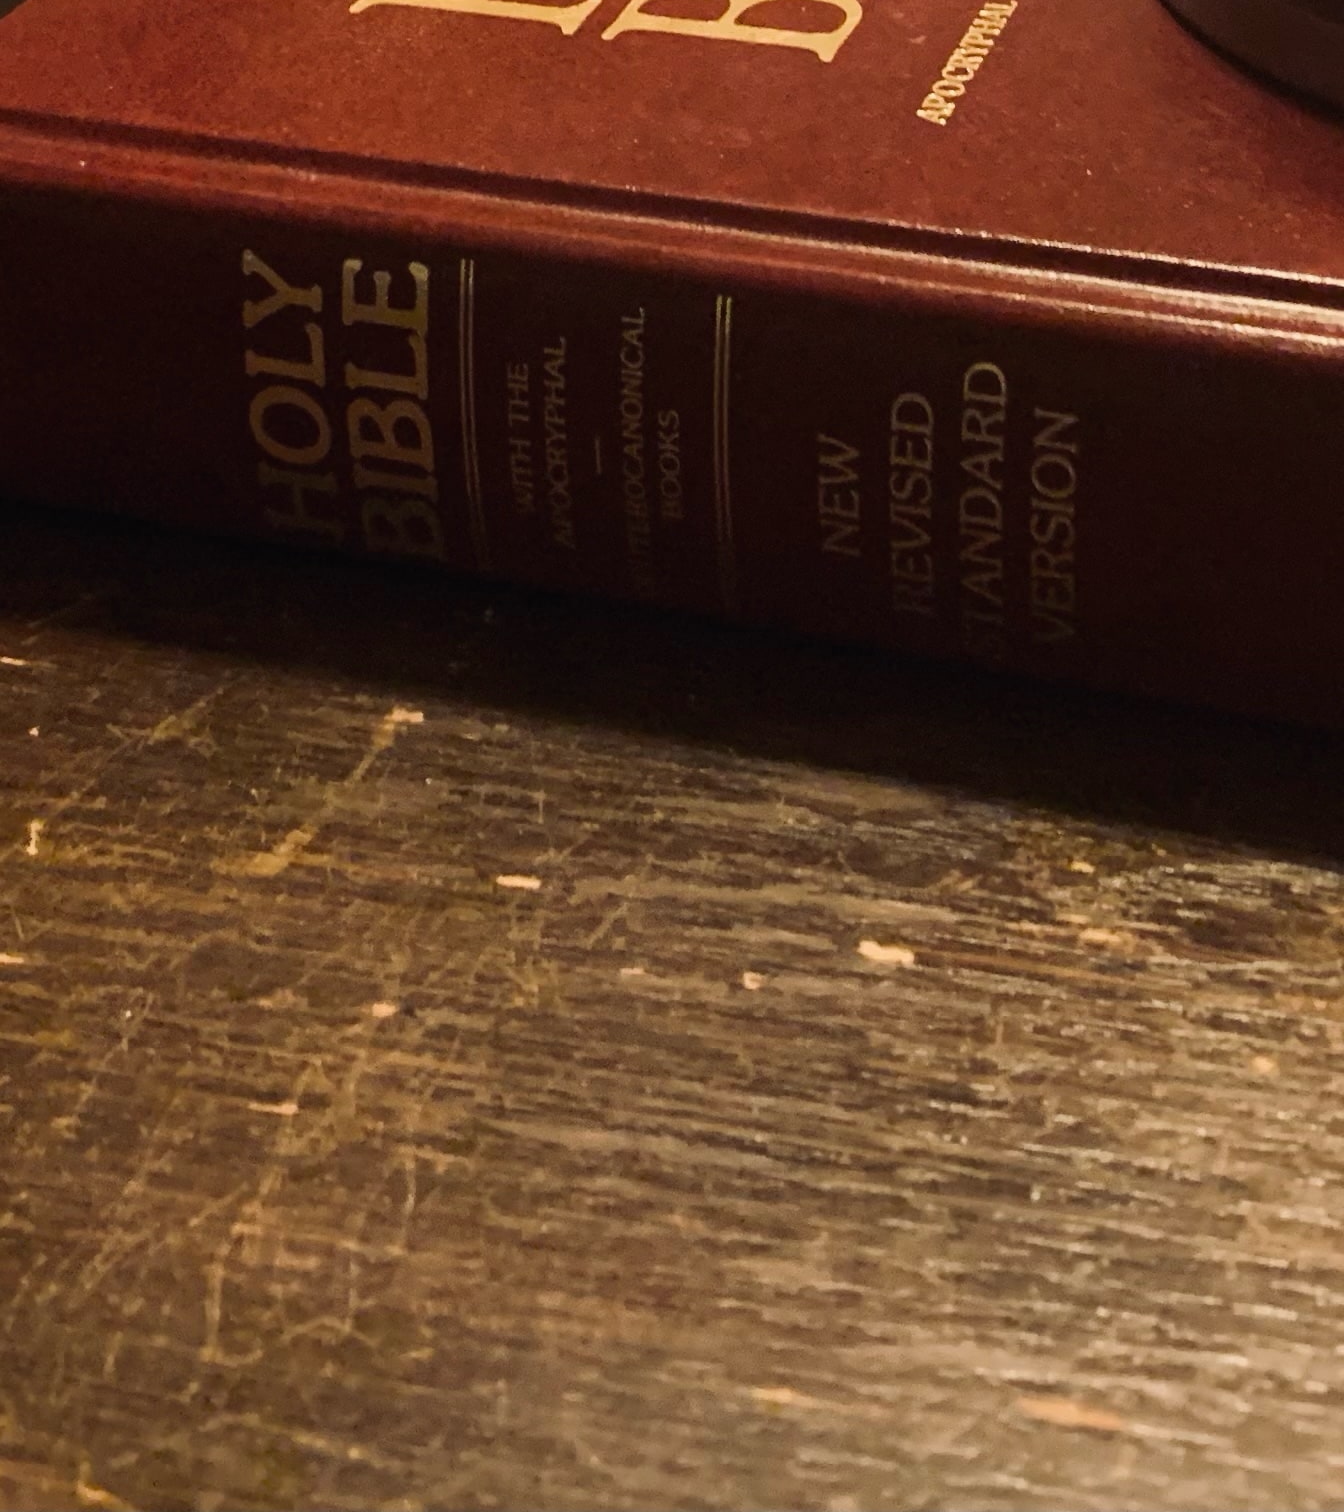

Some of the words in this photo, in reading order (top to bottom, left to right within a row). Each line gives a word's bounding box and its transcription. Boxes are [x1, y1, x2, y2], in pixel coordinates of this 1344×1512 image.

[916, 0, 1018, 126] APOCRYPHAL
[241, 248, 346, 545] HOLY
[342, 257, 448, 562] BIBLE
[505, 360, 532, 428] THE
[506, 436, 537, 515] WITH
[543, 336, 578, 551] APOCRYPHAL
[618, 305, 653, 588] TEROCANONICAL
[657, 408, 685, 521] BOOKS
[815, 432, 862, 558] NEW
[888, 391, 936, 617] REVISED
[958, 360, 1009, 660] TANDARD
[1029, 406, 1080, 644] VERSION
